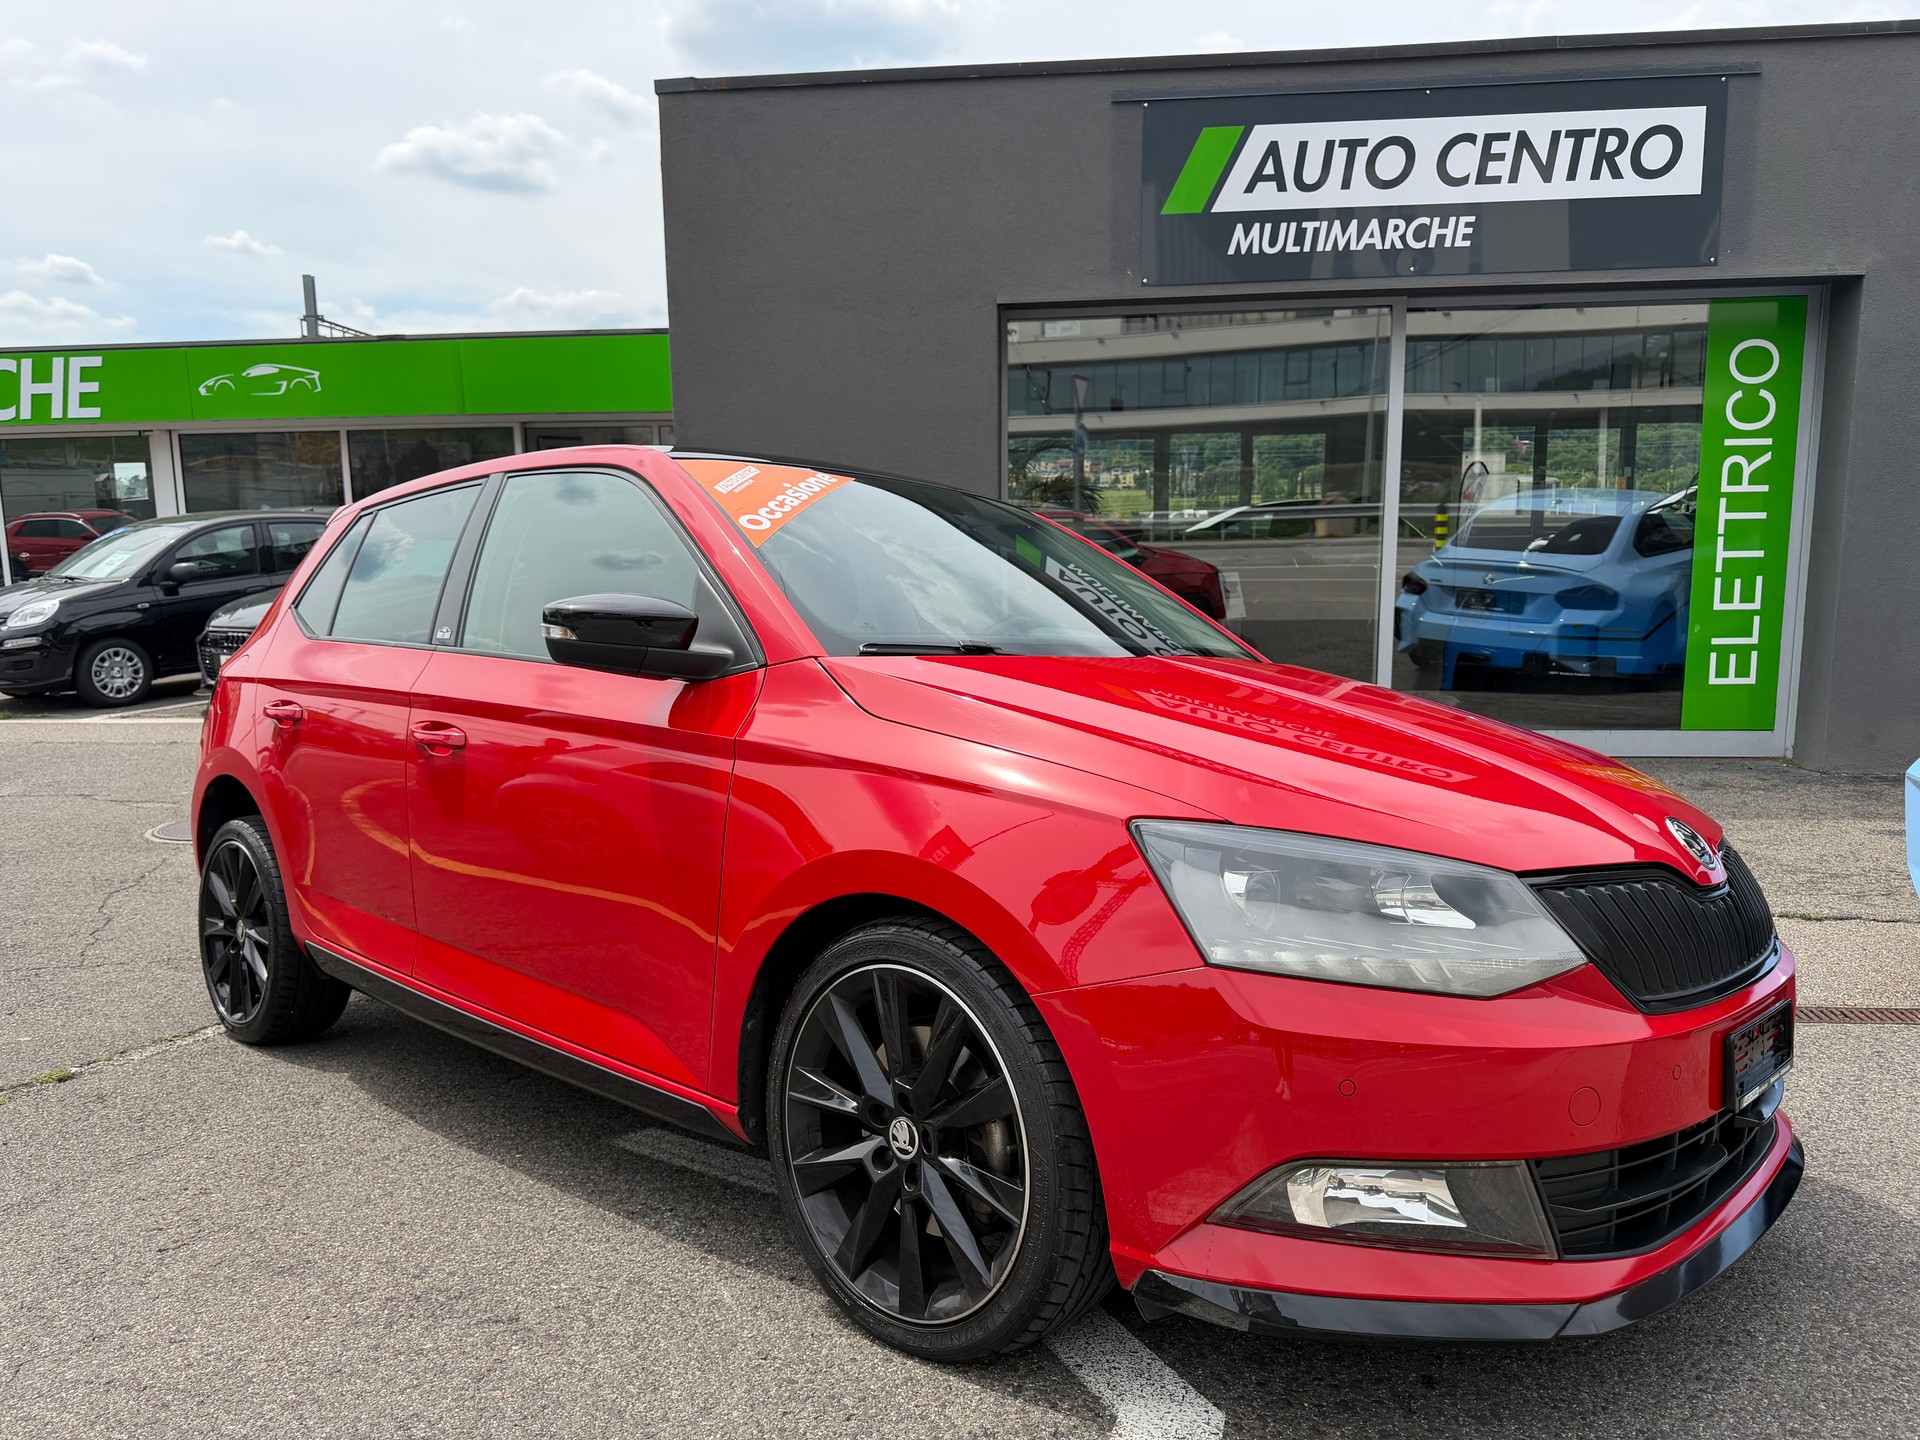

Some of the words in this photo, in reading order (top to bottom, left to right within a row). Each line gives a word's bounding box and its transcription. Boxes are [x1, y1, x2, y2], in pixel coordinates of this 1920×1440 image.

[1243, 136, 1416, 194] AUTO
[1436, 124, 1684, 188] CENTRO
[1227, 215, 1476, 255] MULTIMARCHE
[738, 472, 838, 531] Occasione
[1708, 338, 1780, 685] ELETTRICO
